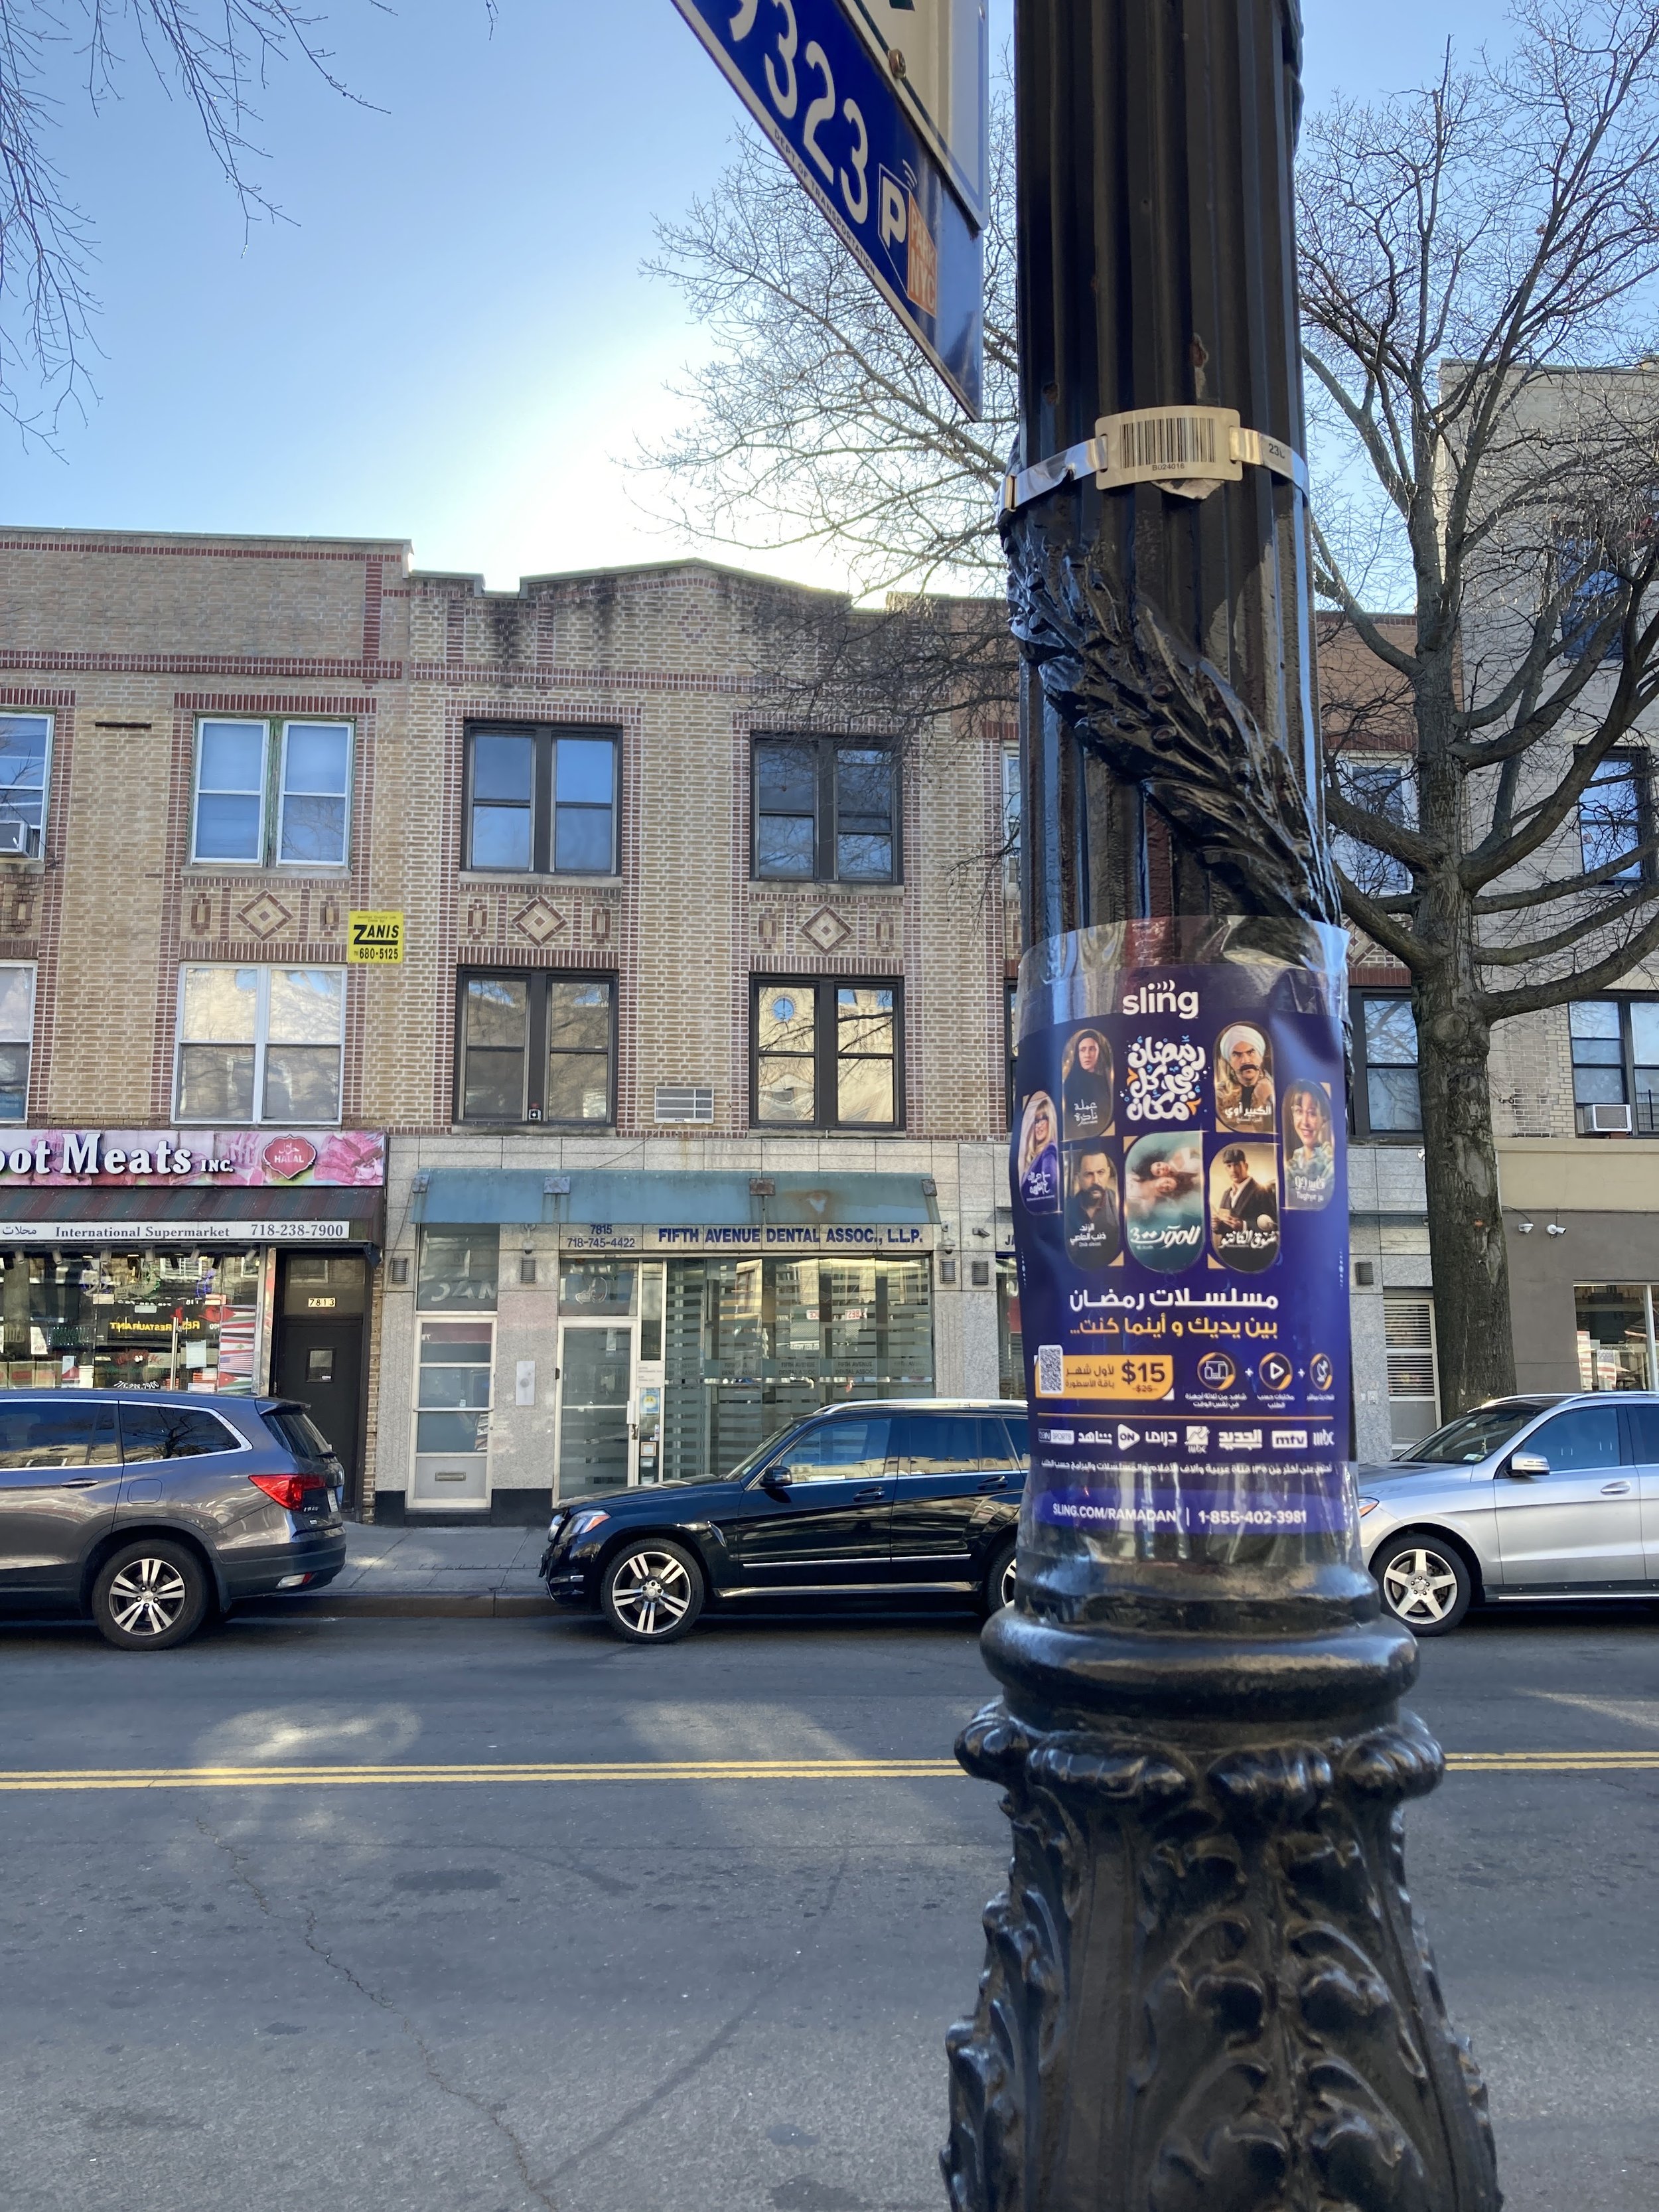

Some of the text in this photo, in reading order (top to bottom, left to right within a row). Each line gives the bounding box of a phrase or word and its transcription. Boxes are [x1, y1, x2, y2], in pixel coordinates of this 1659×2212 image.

[774, 129, 875, 276] DEPT OF TRANSPORTATION
[882, 176, 906, 250] P
[911, 209, 936, 272] PARK
[910, 246, 936, 309] NYC
[1152, 463, 1185, 471] B024016
[354, 924, 399, 944] ZANIS
[1122, 981, 1198, 1019] sling
[1127, 1036, 1206, 1070] رمضان
[1126, 1091, 1190, 1121] مكان
[60, 1132, 192, 1175] Meats
[200, 1159, 234, 1173] INC.
[273, 1155, 305, 1163] HALAL
[56, 1224, 343, 1239] International Supermarket 718-238-7900
[590, 1224, 613, 1234] 7815
[658, 1228, 699, 1243] FIFTH
[705, 1228, 760, 1243] AVENUE
[766, 1228, 821, 1243] DENTAL
[567, 1237, 635, 1248] 718-745-4422
[1069, 1288, 1279, 1312] مسلسلات رمضان
[1124, 1312, 1167, 1338] أينما
[1171, 1319, 1184, 1337] و
[1187, 1317, 1242, 1339] يديك
[1245, 1317, 1278, 1339] بين
[1121, 1359, 1166, 1385] $15
[1052, 1433, 1072, 1441] SPORTS
[1120, 1432, 1135, 1441] ON
[1145, 1430, 1178, 1447] دراما
[1218, 1429, 1263, 1450] الجديد
[1275, 1434, 1305, 1445] mtv
[1052, 1503, 1307, 1524] SLING.COM/RAMADAN 1-855-402-3981
